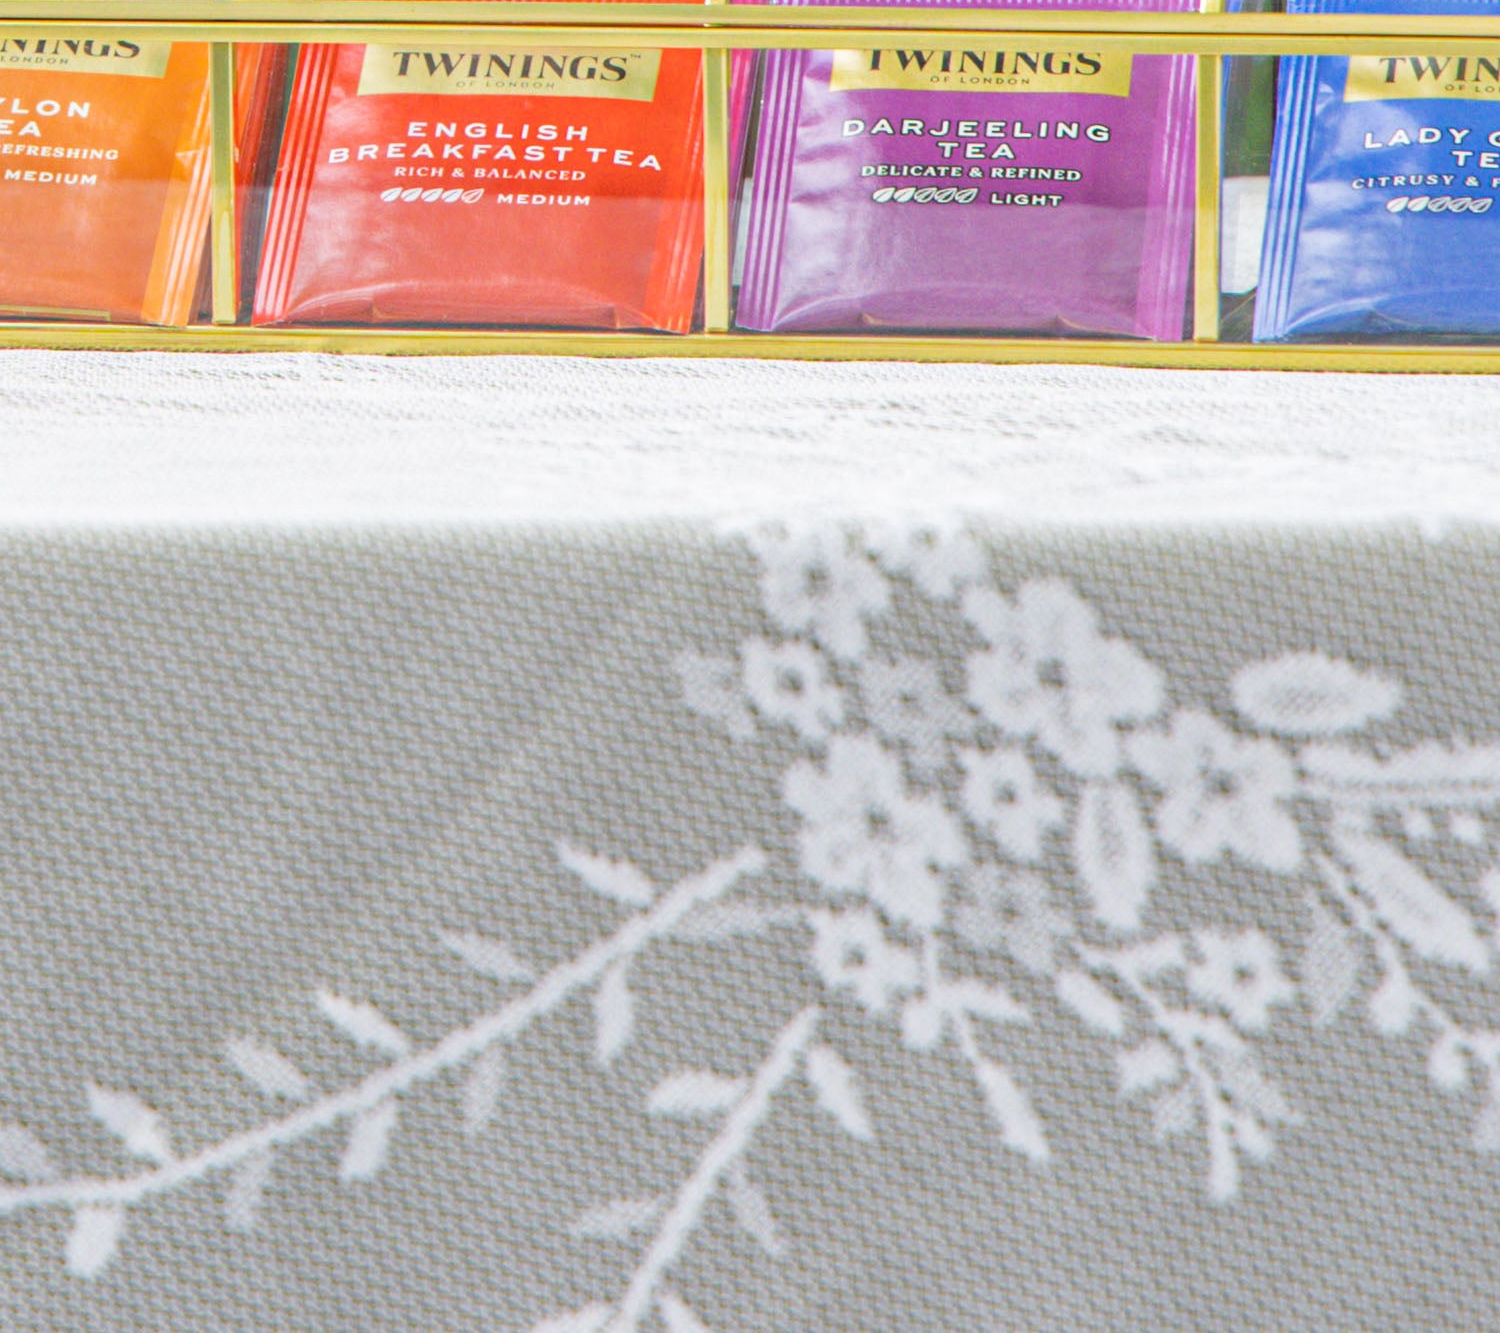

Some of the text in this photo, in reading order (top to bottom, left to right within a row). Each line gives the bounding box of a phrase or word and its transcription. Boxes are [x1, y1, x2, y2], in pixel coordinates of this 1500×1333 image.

[0, 55, 69, 65] LONDON
[455, 80, 556, 90] OF LONDON
[929, 75, 1031, 85] OF LONDON
[1444, 83, 1465, 93] OF
[407, 121, 588, 141] ENGLISH
[841, 118, 1111, 143] DARJEELING
[1363, 127, 1471, 150] LADY
[328, 142, 663, 171] BREAKFAST TEA
[936, 141, 1016, 160] TEA
[4, 168, 98, 185] MEDIUM
[394, 166, 587, 181] RICH & BALANCED
[861, 164, 1083, 182] DELICATE & REFINED
[1351, 173, 1456, 190] CITRUSY
[1464, 175, 1480, 188] &
[497, 193, 591, 207] MEDIUM
[989, 192, 1064, 208] LIGHT
